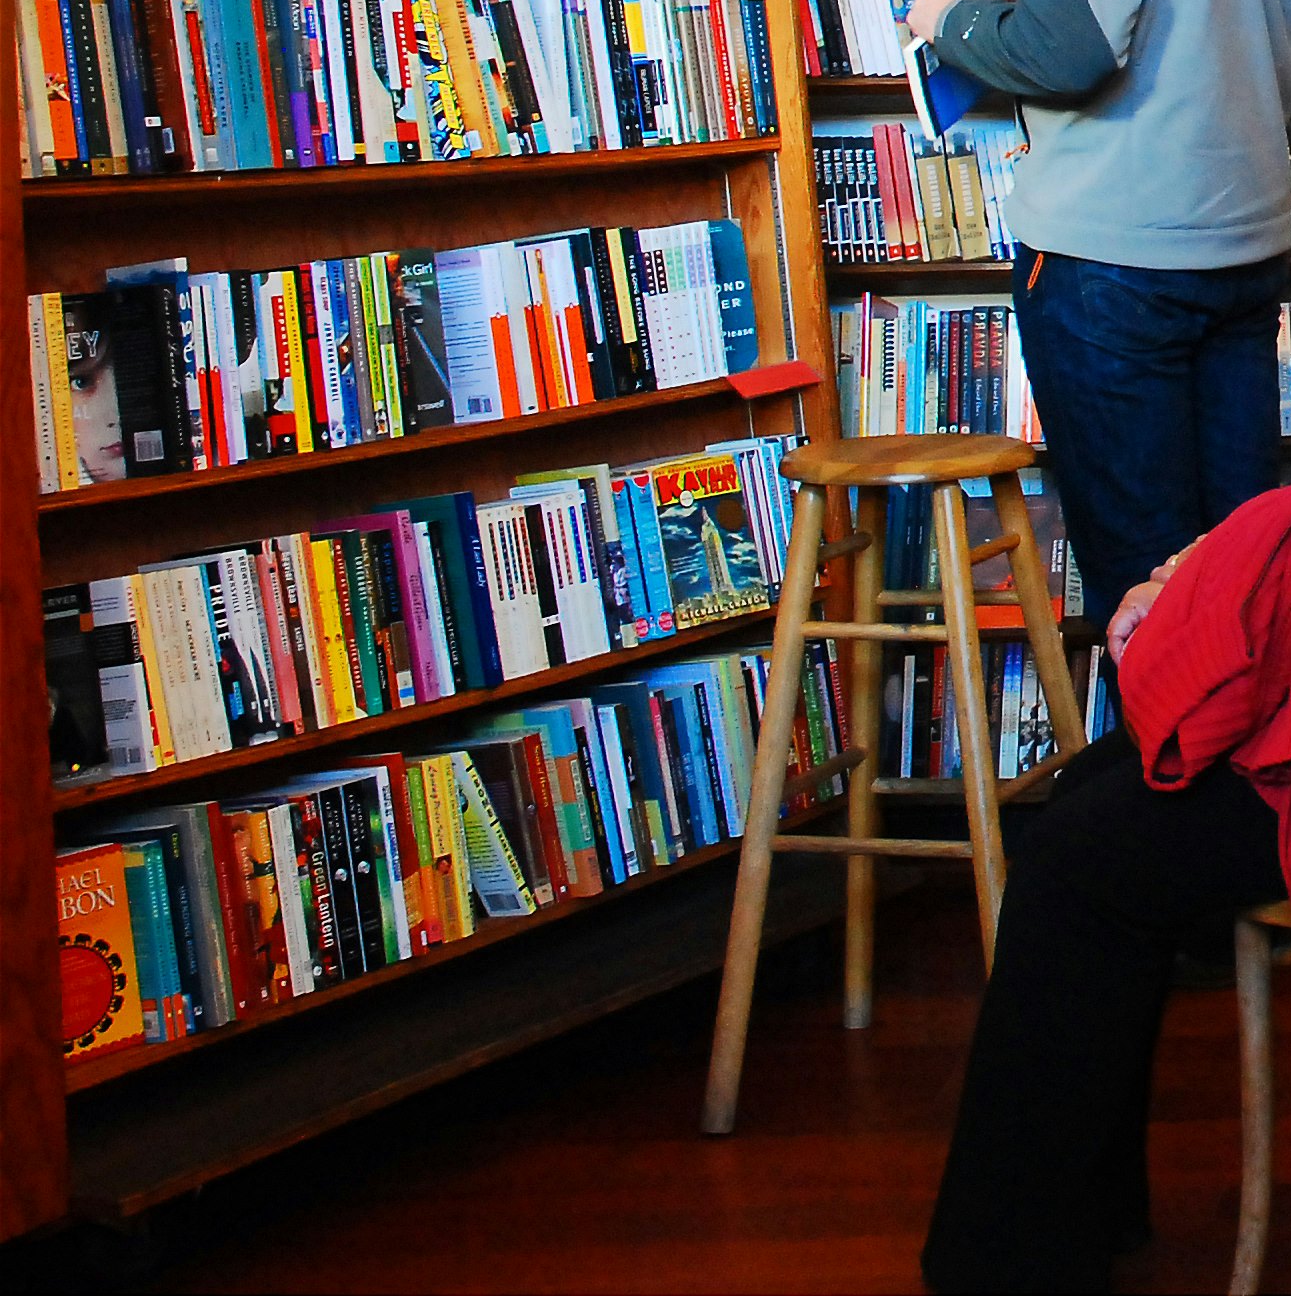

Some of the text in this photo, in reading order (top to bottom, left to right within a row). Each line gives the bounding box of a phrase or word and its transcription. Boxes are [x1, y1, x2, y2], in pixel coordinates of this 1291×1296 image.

[412, 261, 434, 277] Girl
[208, 584, 231, 643] PRIDE
[311, 850, 335, 949] Green Lantern
